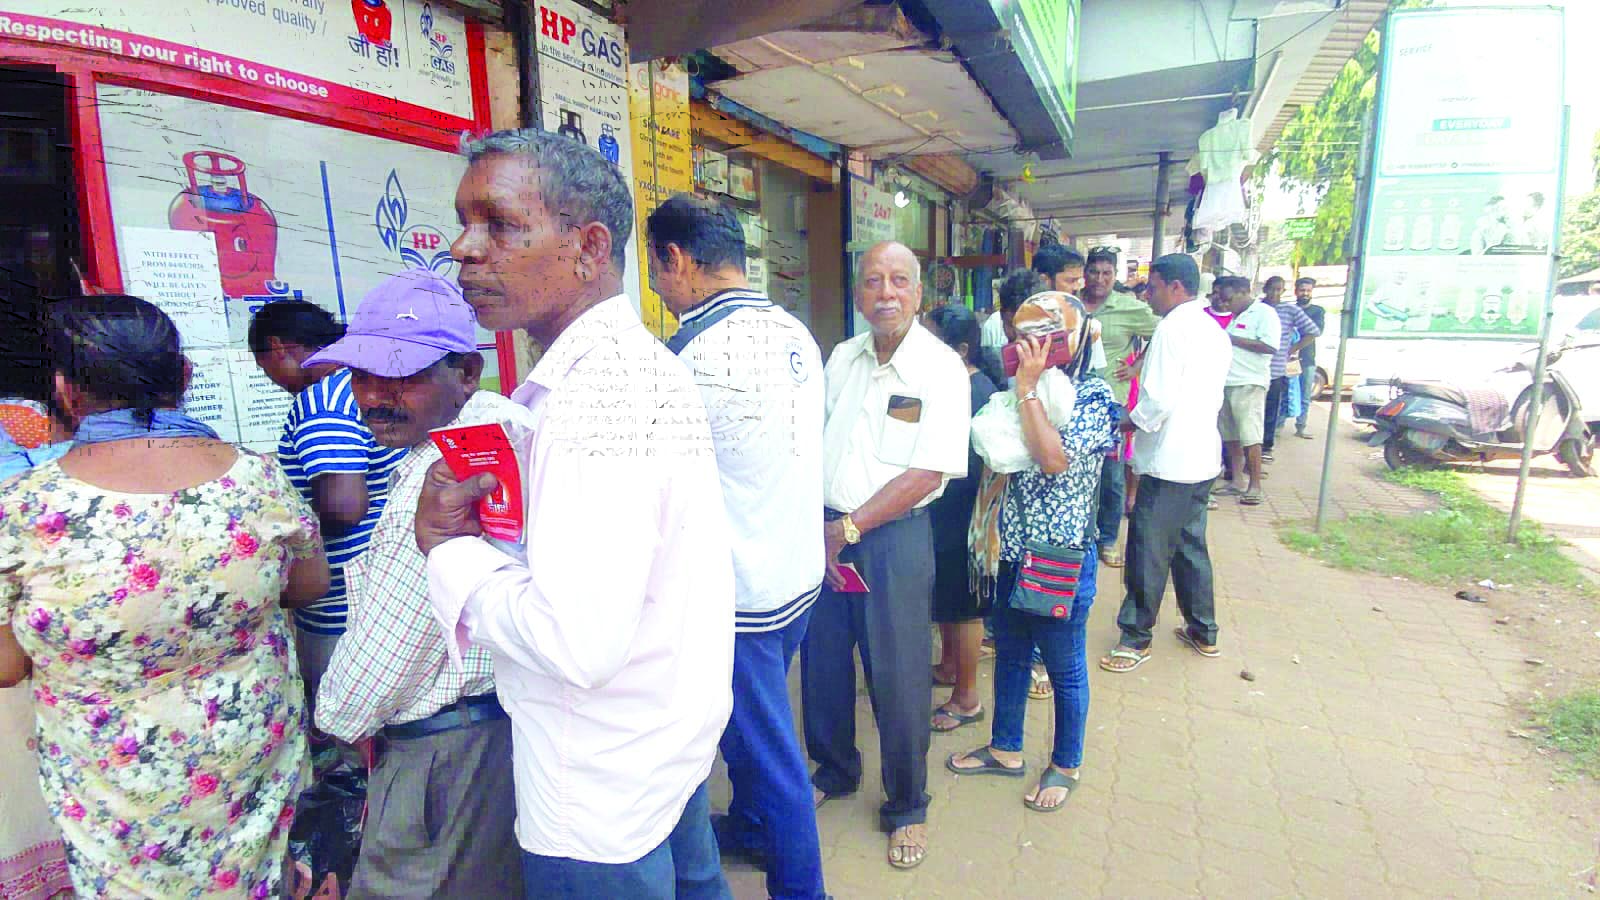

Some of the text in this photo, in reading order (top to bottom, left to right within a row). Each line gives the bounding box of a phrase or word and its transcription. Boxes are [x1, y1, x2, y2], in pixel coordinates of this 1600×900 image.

[272, 7, 317, 34] quality
[540, 5, 622, 68] HP GAS
[0, 16, 329, 98] Respecting your right to choose
[549, 45, 561, 58] the
[412, 231, 441, 250] HP
[143, 250, 199, 260] WITH EFFECT
[141, 260, 167, 268] FROM
[144, 280, 168, 289] WILL
[158, 291, 196, 299] WITHOUT
